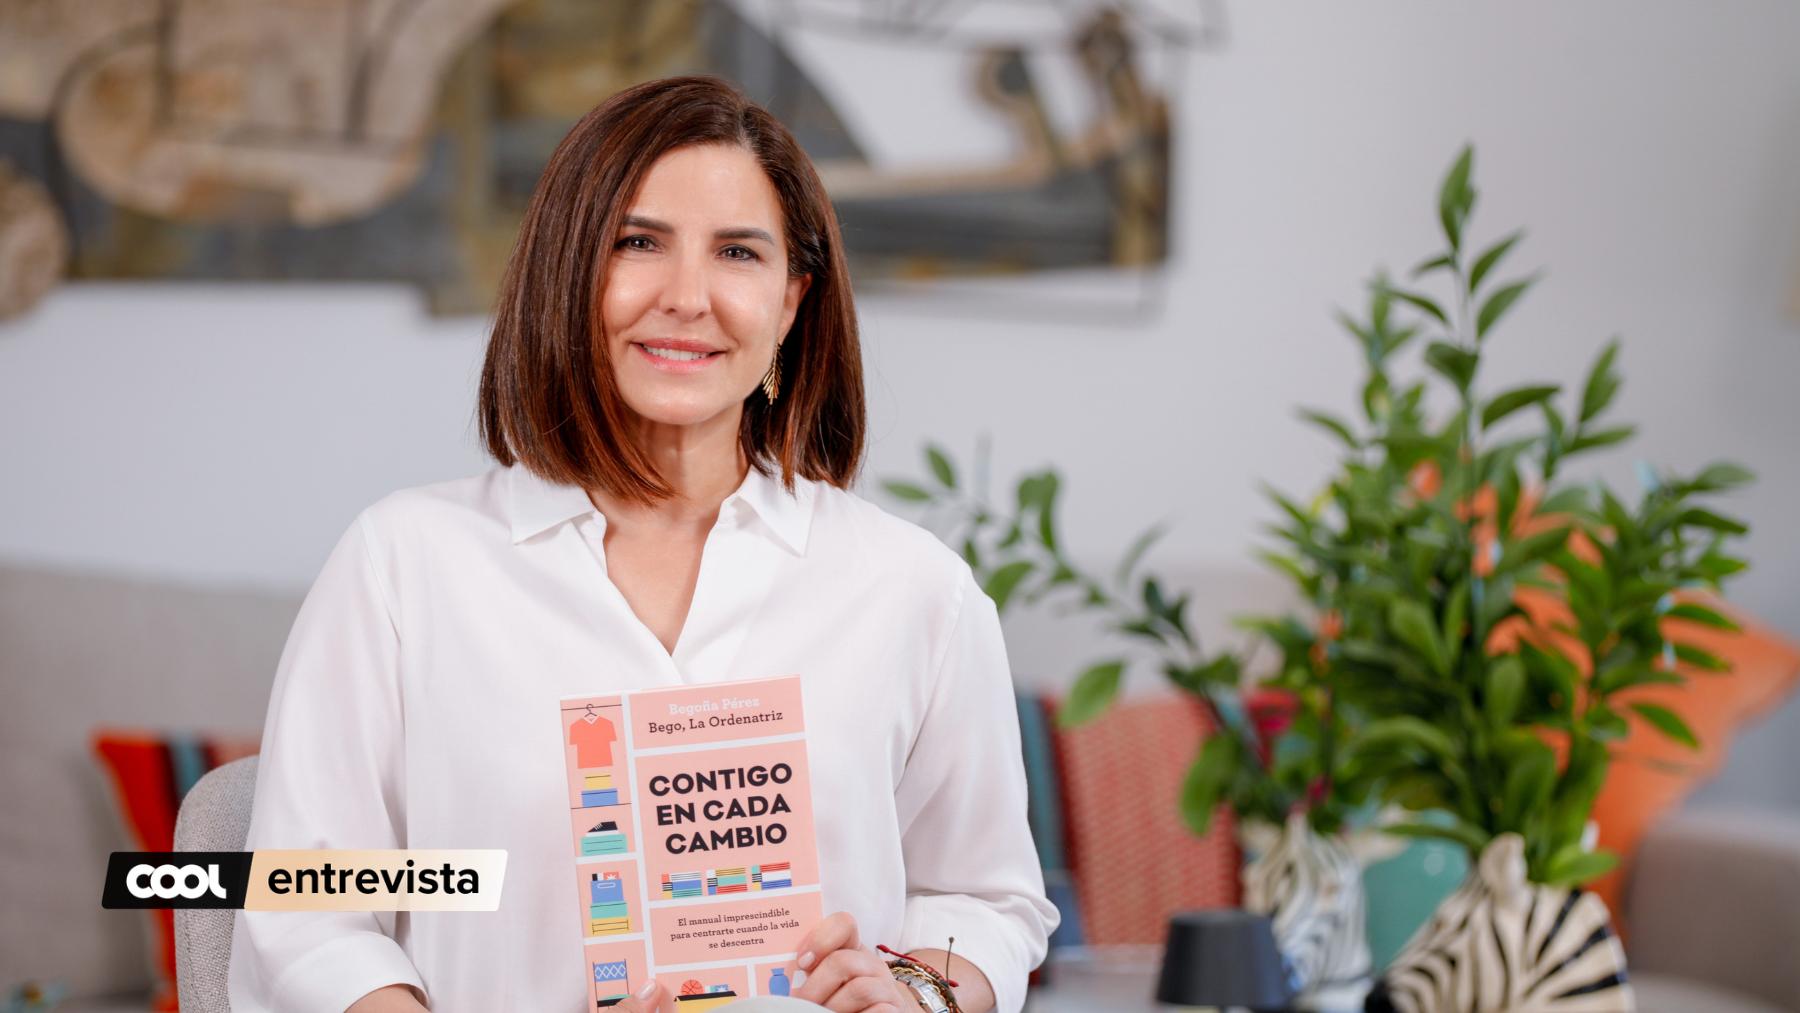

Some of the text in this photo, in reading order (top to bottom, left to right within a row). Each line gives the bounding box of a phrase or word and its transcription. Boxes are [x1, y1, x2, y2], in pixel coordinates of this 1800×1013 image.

[669, 697, 759, 715] Begoña Pérez
[649, 710, 783, 734] Bego, La Ordenatriz
[649, 762, 793, 797] CONTIGO
[656, 793, 792, 826] EN CADA
[665, 822, 788, 855] CAMBIO
[678, 908, 790, 927] El manual imprescindible
[670, 919, 800, 942] para centrarte cuando la vida
[720, 936, 764, 948] descentra
